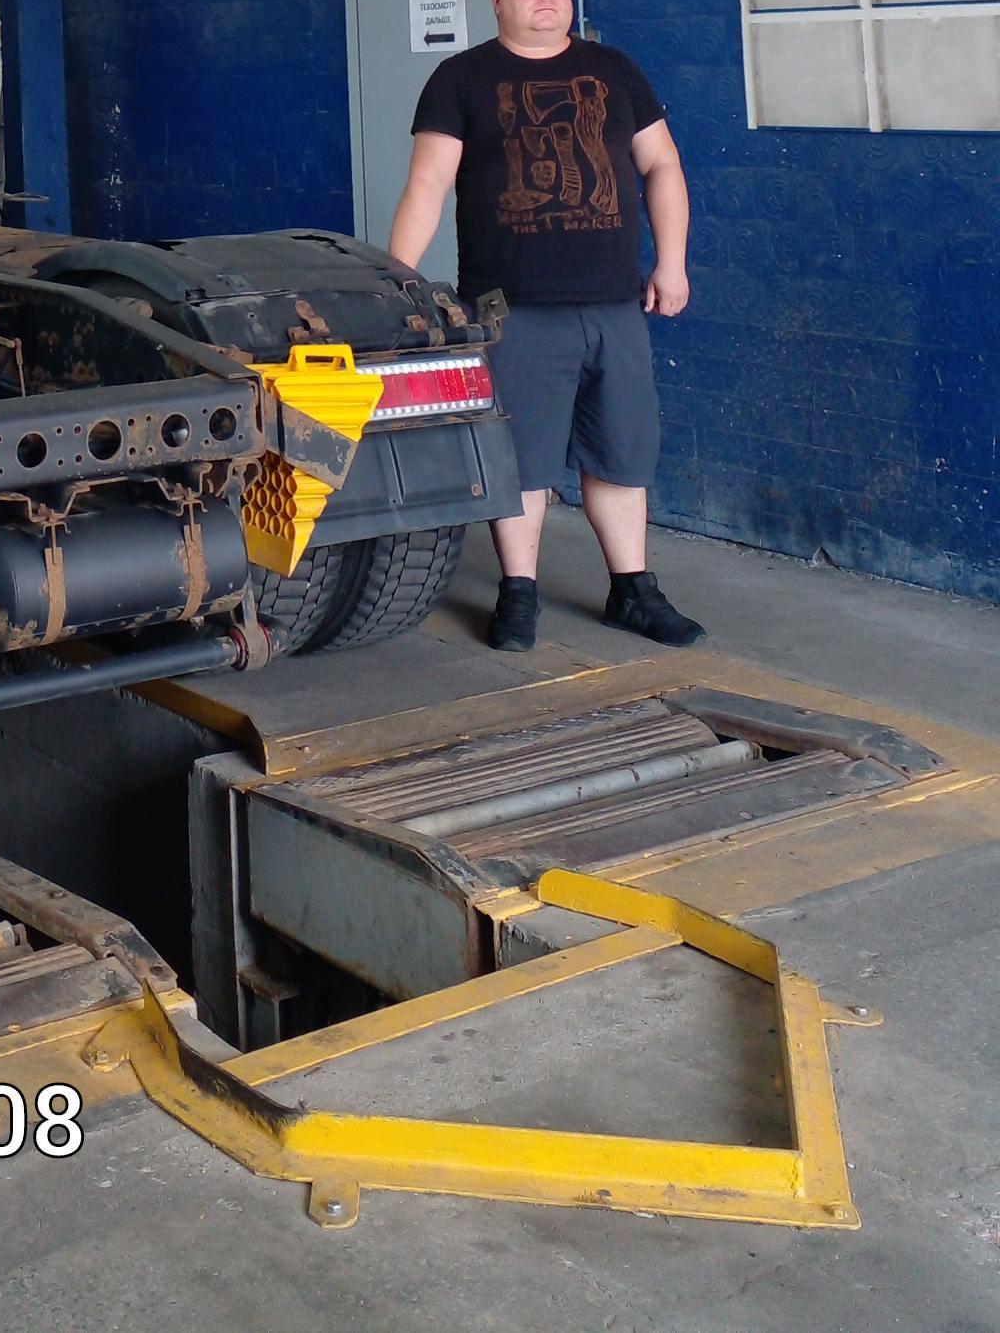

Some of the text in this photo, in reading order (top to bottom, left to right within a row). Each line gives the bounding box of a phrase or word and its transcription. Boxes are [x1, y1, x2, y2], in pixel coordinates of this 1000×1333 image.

[420, 1, 456, 12] ТЕХОСМОТР
[425, 15, 452, 27] ДАЛЬШЕ
[511, 223, 539, 235] THE
